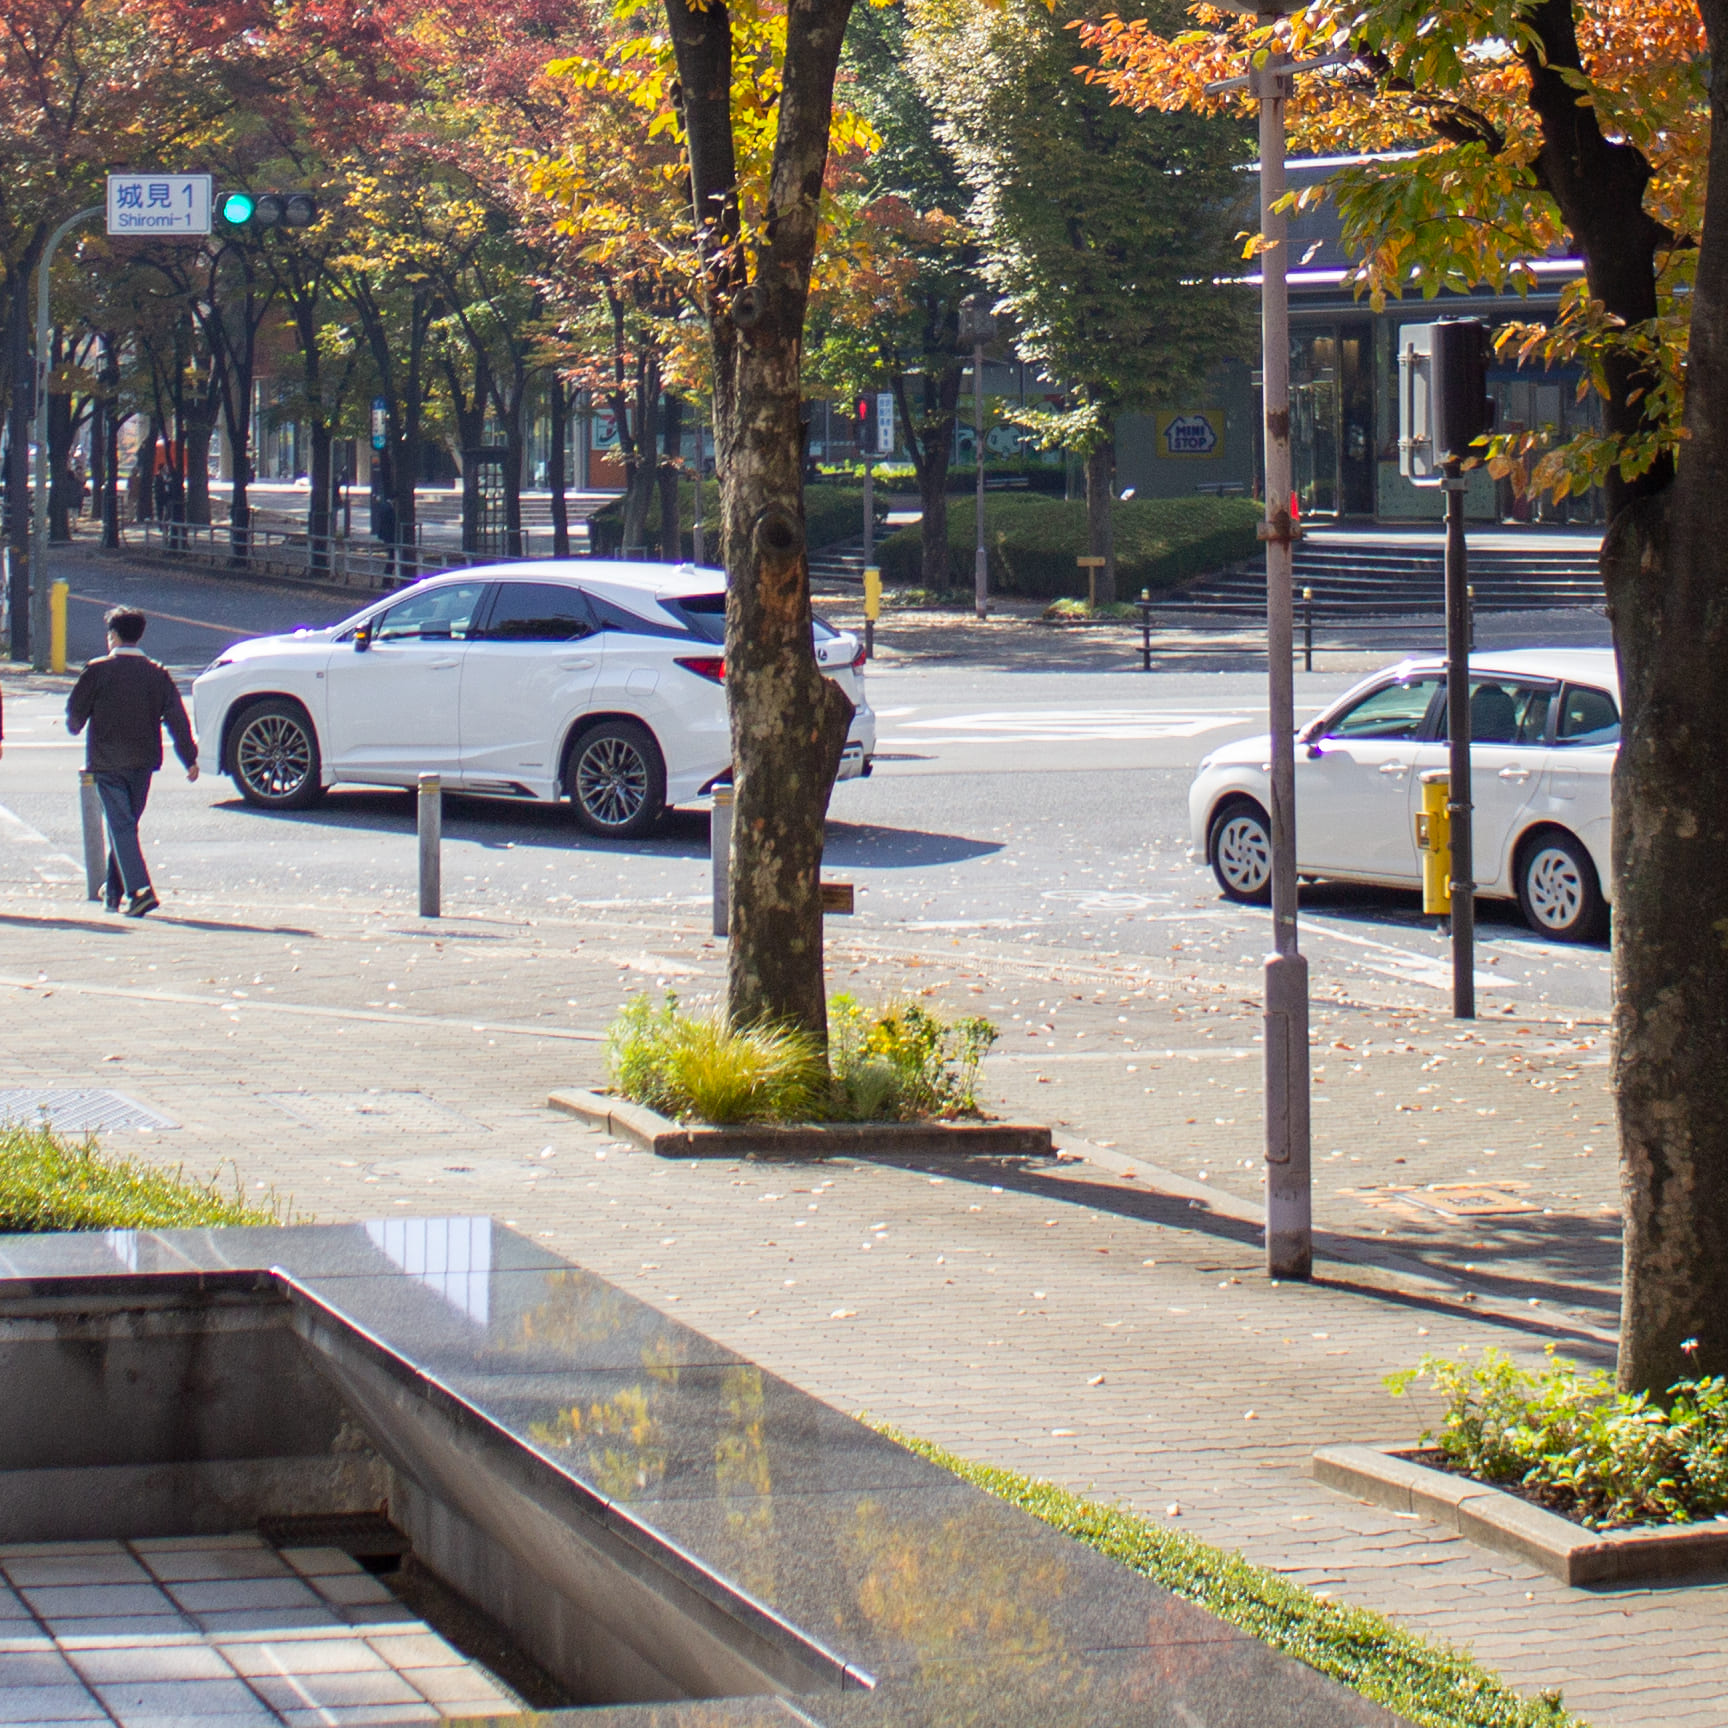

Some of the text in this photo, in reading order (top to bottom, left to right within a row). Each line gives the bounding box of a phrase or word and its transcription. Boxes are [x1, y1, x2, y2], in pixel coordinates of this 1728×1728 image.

[118, 213, 192, 226] Shiromi-1
[1175, 426, 1205, 437] MINI
[1174, 437, 1207, 449] STOP
